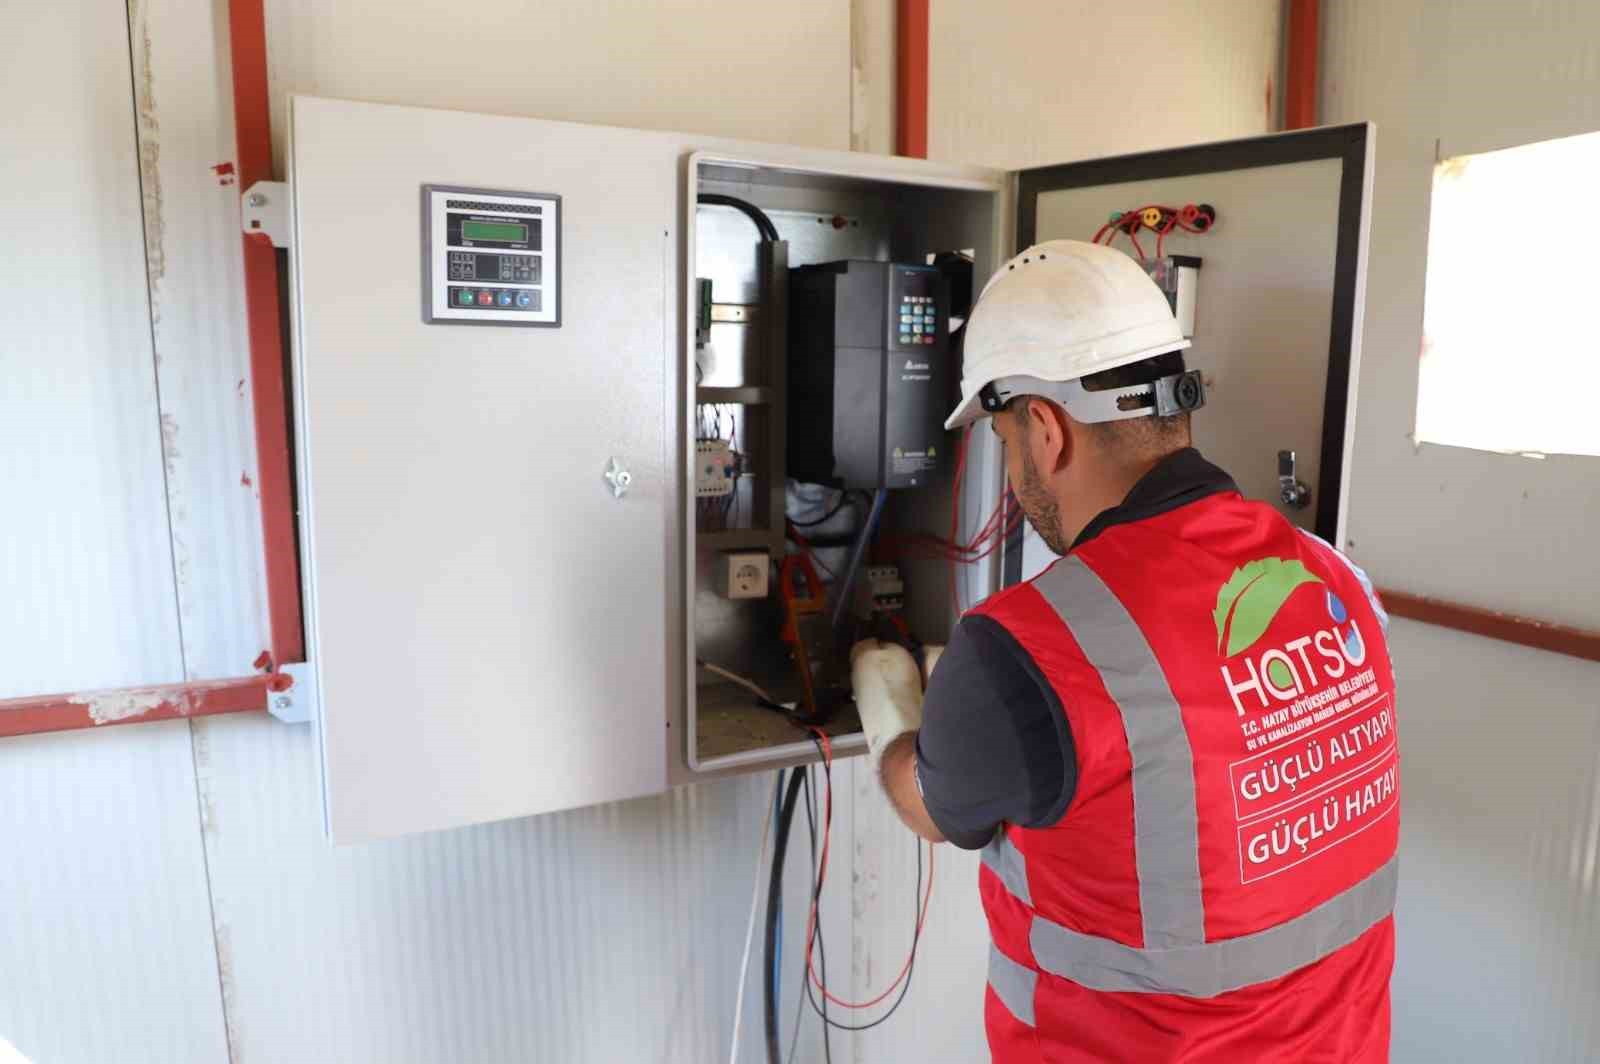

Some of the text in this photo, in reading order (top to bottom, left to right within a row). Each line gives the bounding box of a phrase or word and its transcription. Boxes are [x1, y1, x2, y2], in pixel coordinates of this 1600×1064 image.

[1240, 707, 1393, 801] GÜÇLÜ ALTYAPI
[1241, 720, 1261, 737] T.C.
[1262, 709, 1290, 729] HATAY
[1248, 764, 1397, 864] GÜÇLÜ HATAY
